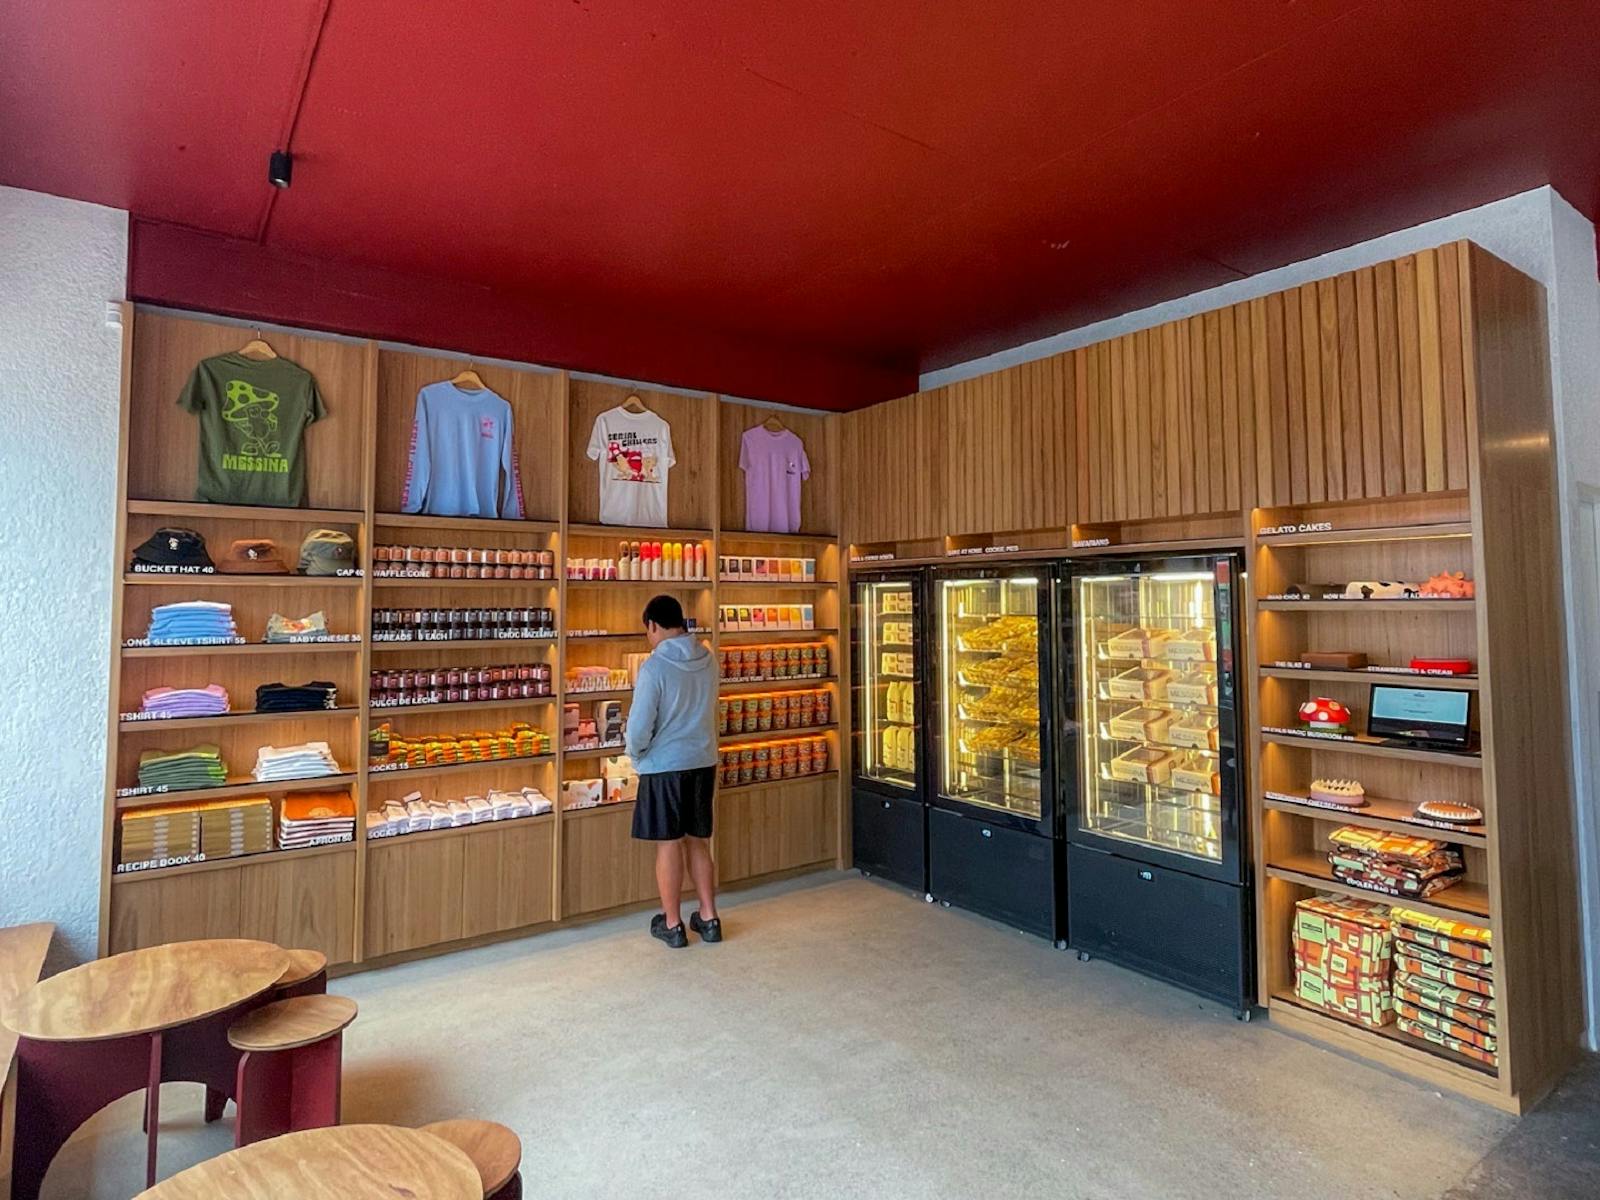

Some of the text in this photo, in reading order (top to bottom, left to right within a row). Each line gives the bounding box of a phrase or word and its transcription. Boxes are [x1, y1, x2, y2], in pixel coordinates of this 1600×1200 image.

[222, 454, 288, 472] MESSINA
[1259, 522, 1332, 534] GELATO CAKES
[134, 564, 178, 573] BUCKET
[202, 566, 214, 574] 40
[373, 570, 406, 578] WAFFLE
[153, 637, 195, 646] SLEEVE
[234, 636, 246, 645] 55
[289, 635, 315, 643] BABY
[317, 634, 350, 643] ONESIE
[372, 633, 412, 641] SPREADS
[425, 632, 448, 640] EACH
[368, 696, 439, 707] DULCE DE LECHE
[119, 711, 157, 721] TSHIRT
[116, 784, 169, 797] TSHIRT 45
[117, 860, 158, 873] RECIPE
[159, 855, 191, 867] BOOK
